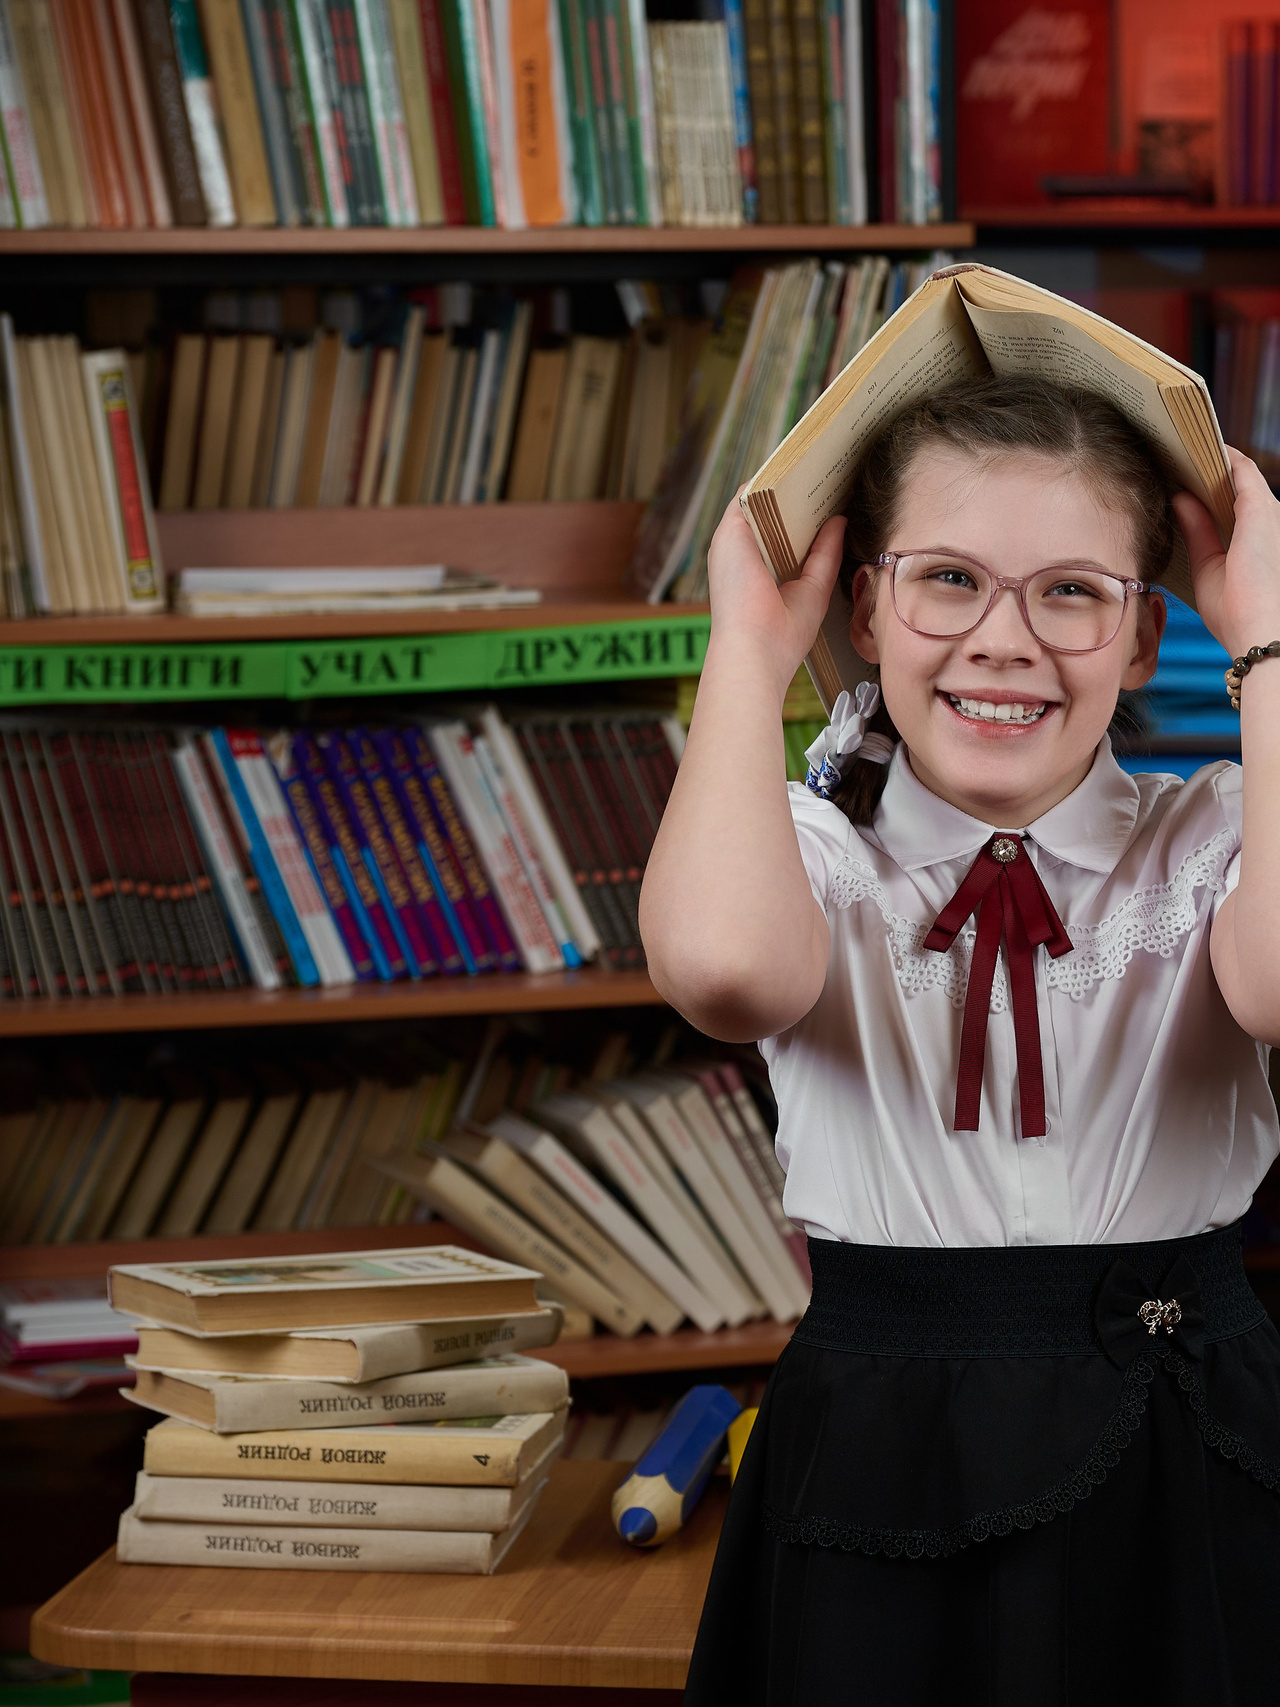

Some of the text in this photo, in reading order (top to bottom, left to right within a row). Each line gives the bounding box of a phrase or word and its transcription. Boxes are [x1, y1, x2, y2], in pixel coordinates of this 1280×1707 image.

[867, 381, 878, 394] 163
[0, 654, 47, 690] И
[63, 653, 248, 689] КНИГИ
[299, 645, 432, 686] УЧАТ
[434, 1330, 470, 1353] ЖИВОЙ
[300, 1391, 446, 1414] ЖИВОЙ РОДНИК
[237, 1444, 387, 1465] ЖИВОЙ РОДНИК
[472, 1453, 491, 1467] 4
[222, 1493, 378, 1516] ЖИВОЙ РОДНИК
[205, 1535, 360, 1559] ЖИВОЙ РОДНИК
